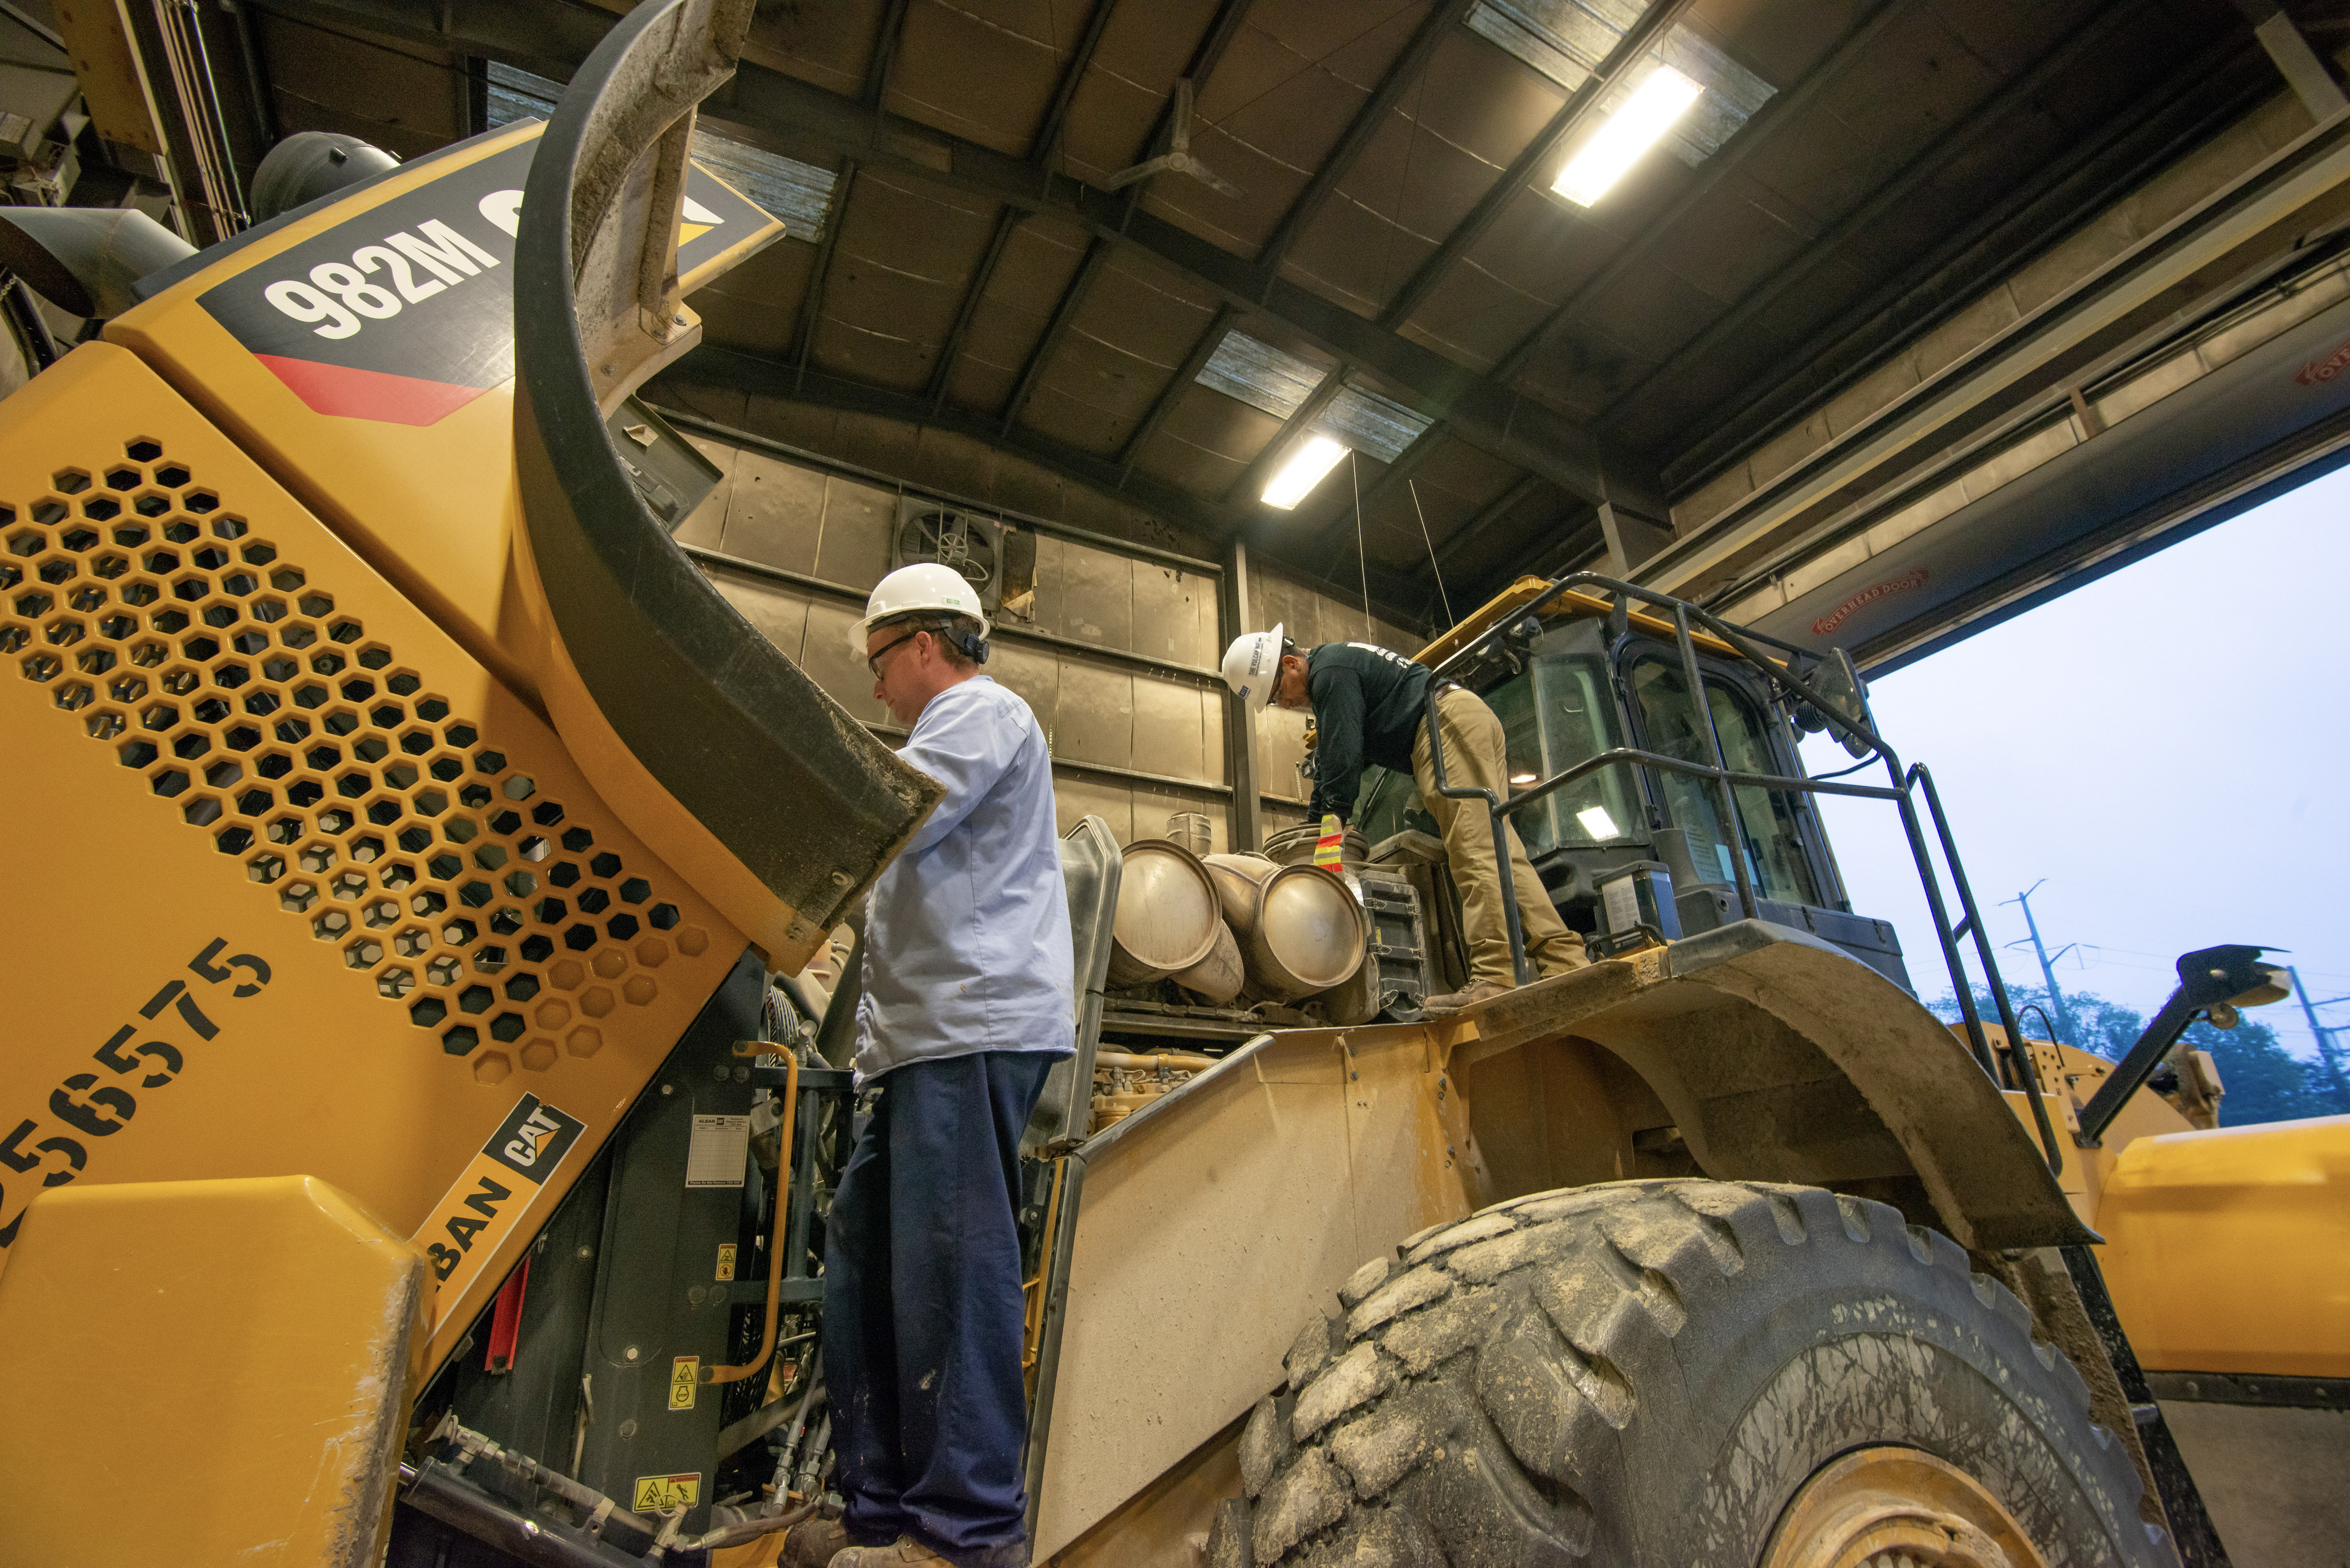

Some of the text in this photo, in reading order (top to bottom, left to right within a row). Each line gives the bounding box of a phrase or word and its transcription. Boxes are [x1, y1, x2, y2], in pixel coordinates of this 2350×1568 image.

[264, 218, 500, 340] 982M
[1825, 580, 1918, 630] OVERHEAD DOOR
[1251, 650, 1259, 666] VULCAN
[504, 1107, 562, 1167] CAT
